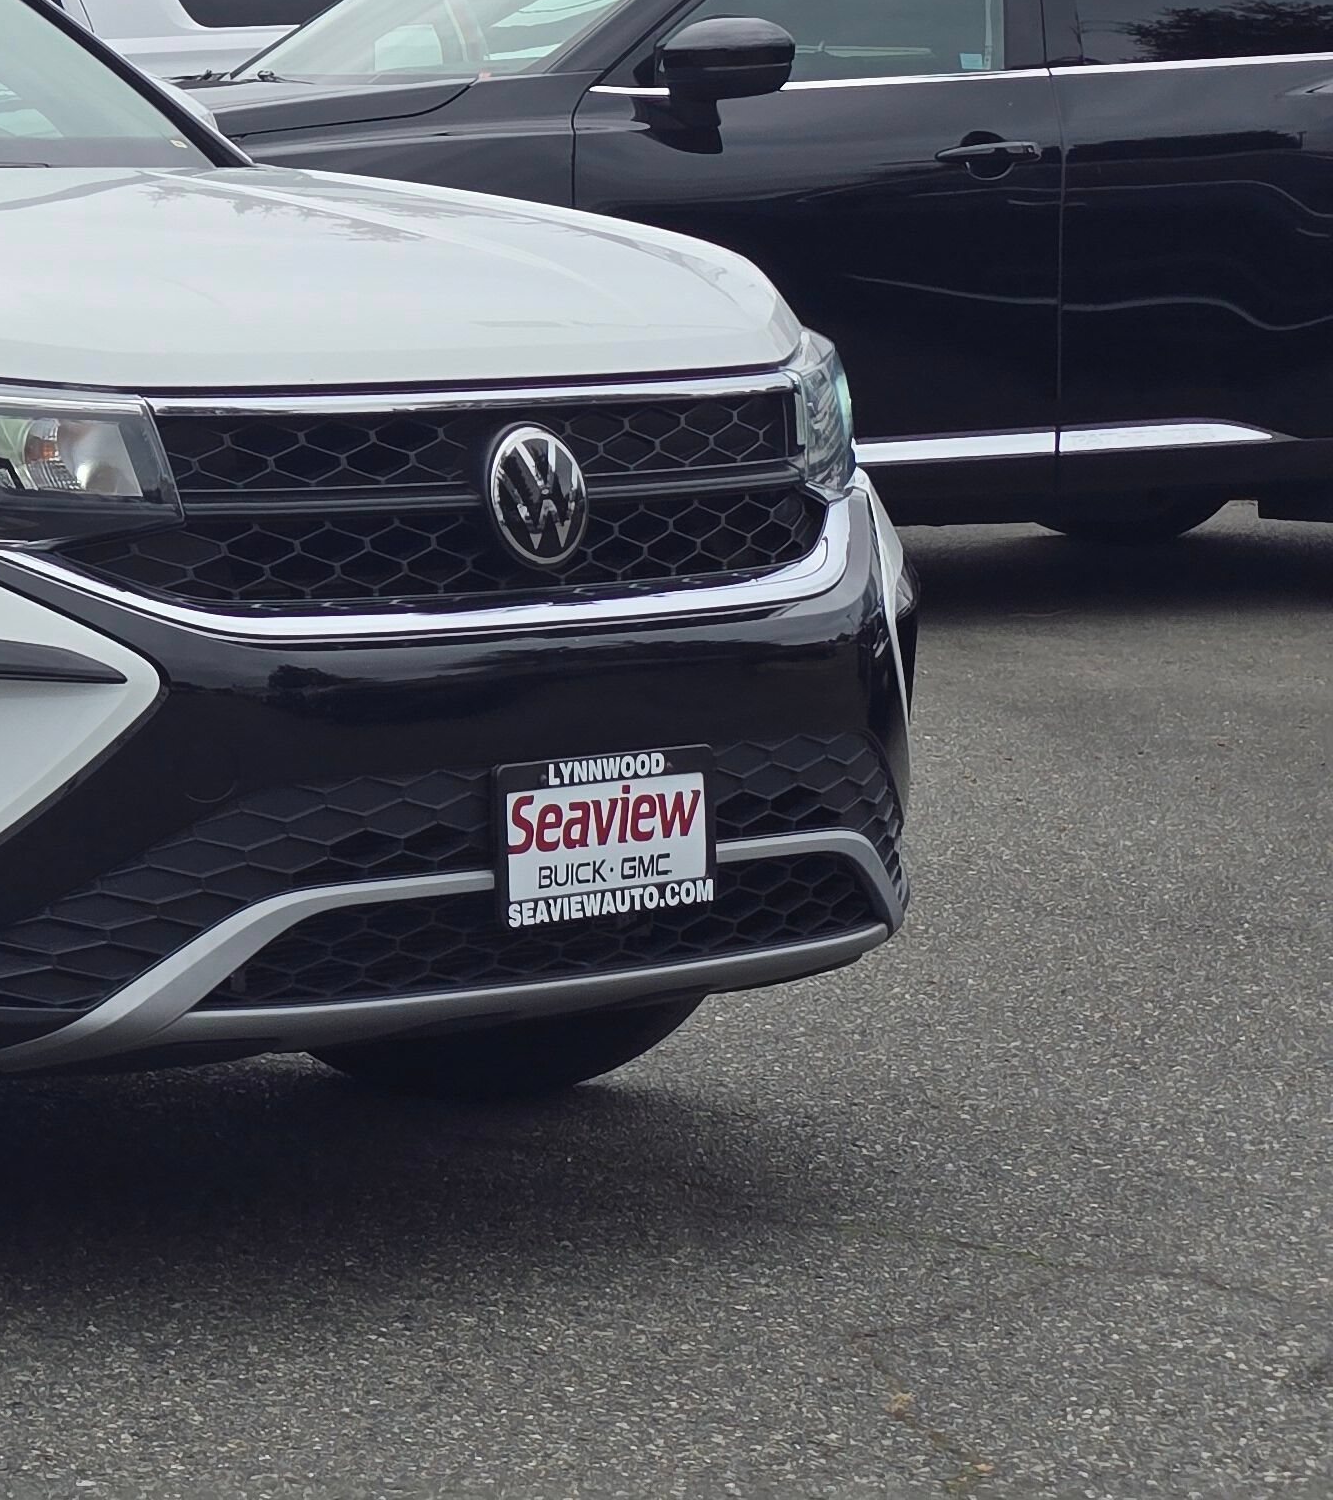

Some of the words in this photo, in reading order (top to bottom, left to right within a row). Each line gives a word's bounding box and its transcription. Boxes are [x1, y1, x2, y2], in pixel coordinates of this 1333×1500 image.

[547, 752, 665, 786] LYNNWOOD
[507, 784, 701, 855] Seaview
[538, 859, 608, 889] BUICK
[620, 852, 673, 880] GMC
[508, 878, 714, 928] SEAVIEWAUTO.COM
